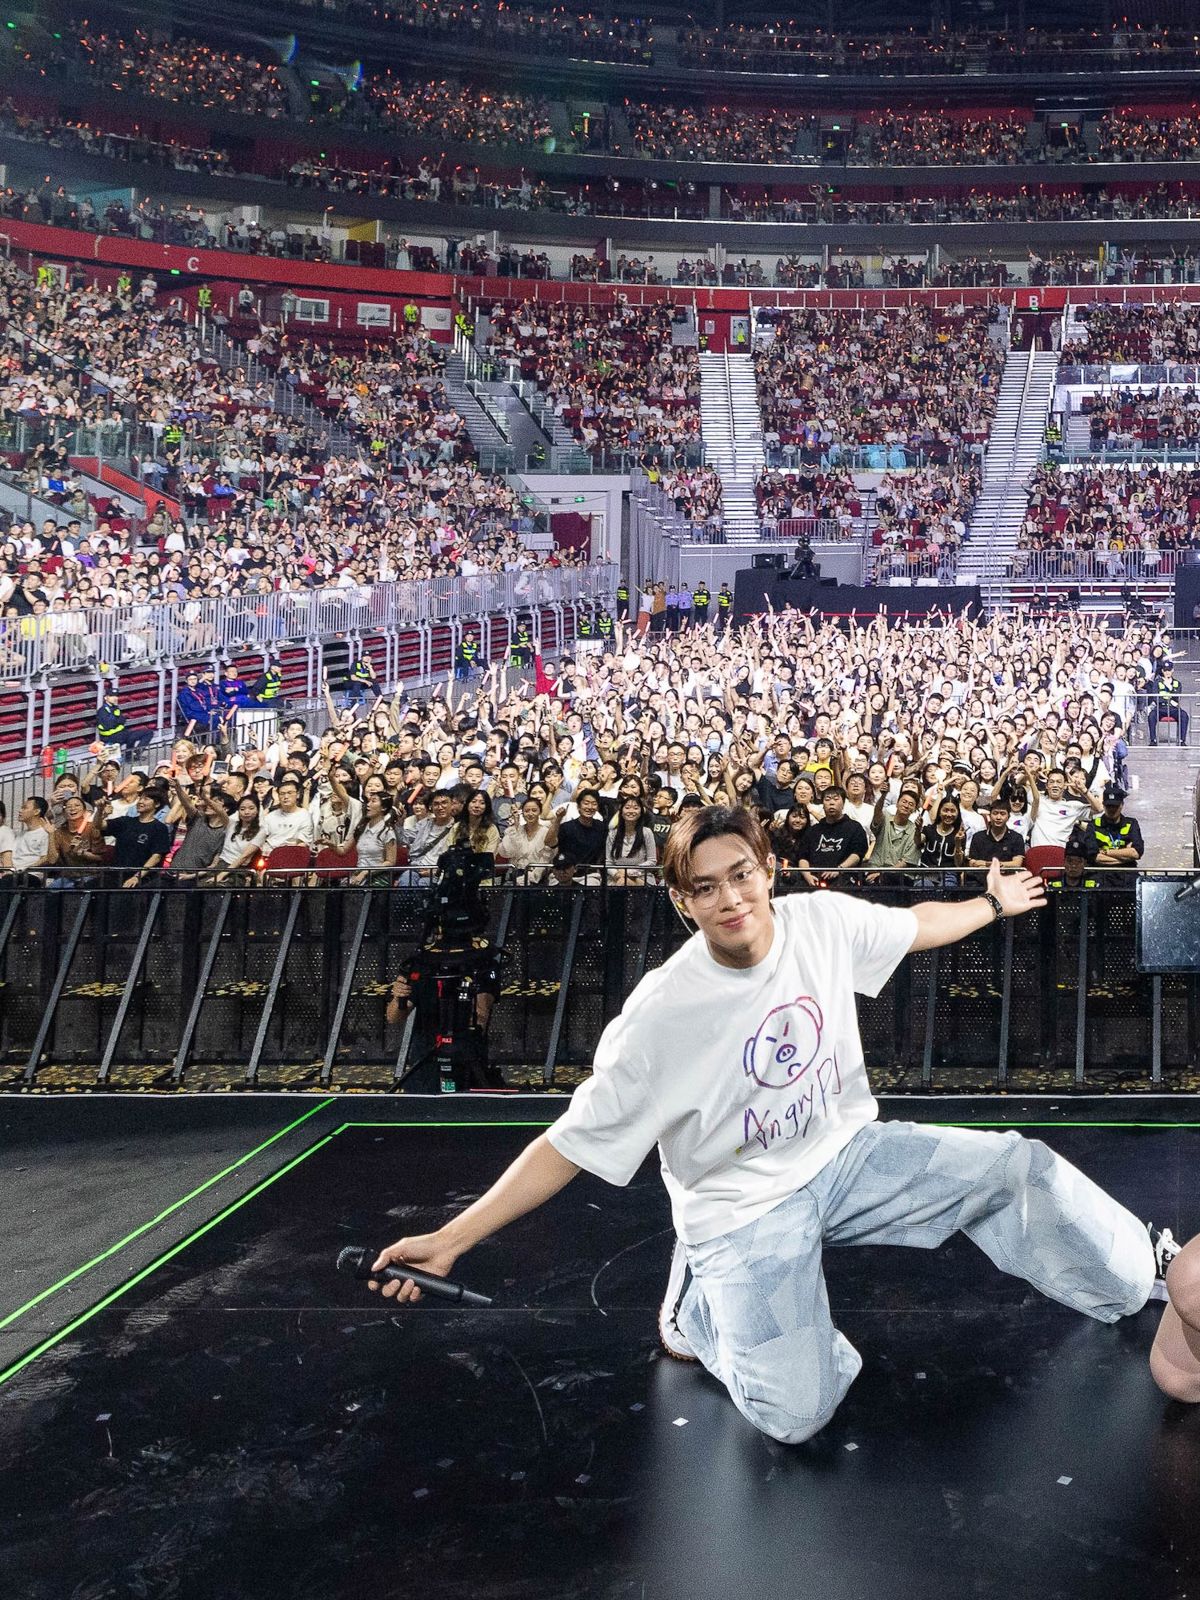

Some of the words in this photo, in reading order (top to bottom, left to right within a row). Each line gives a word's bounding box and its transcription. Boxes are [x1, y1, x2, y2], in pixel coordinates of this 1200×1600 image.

[187, 256, 200, 271] C
[1029, 295, 1039, 308] B
[653, 823, 671, 833] 1977
